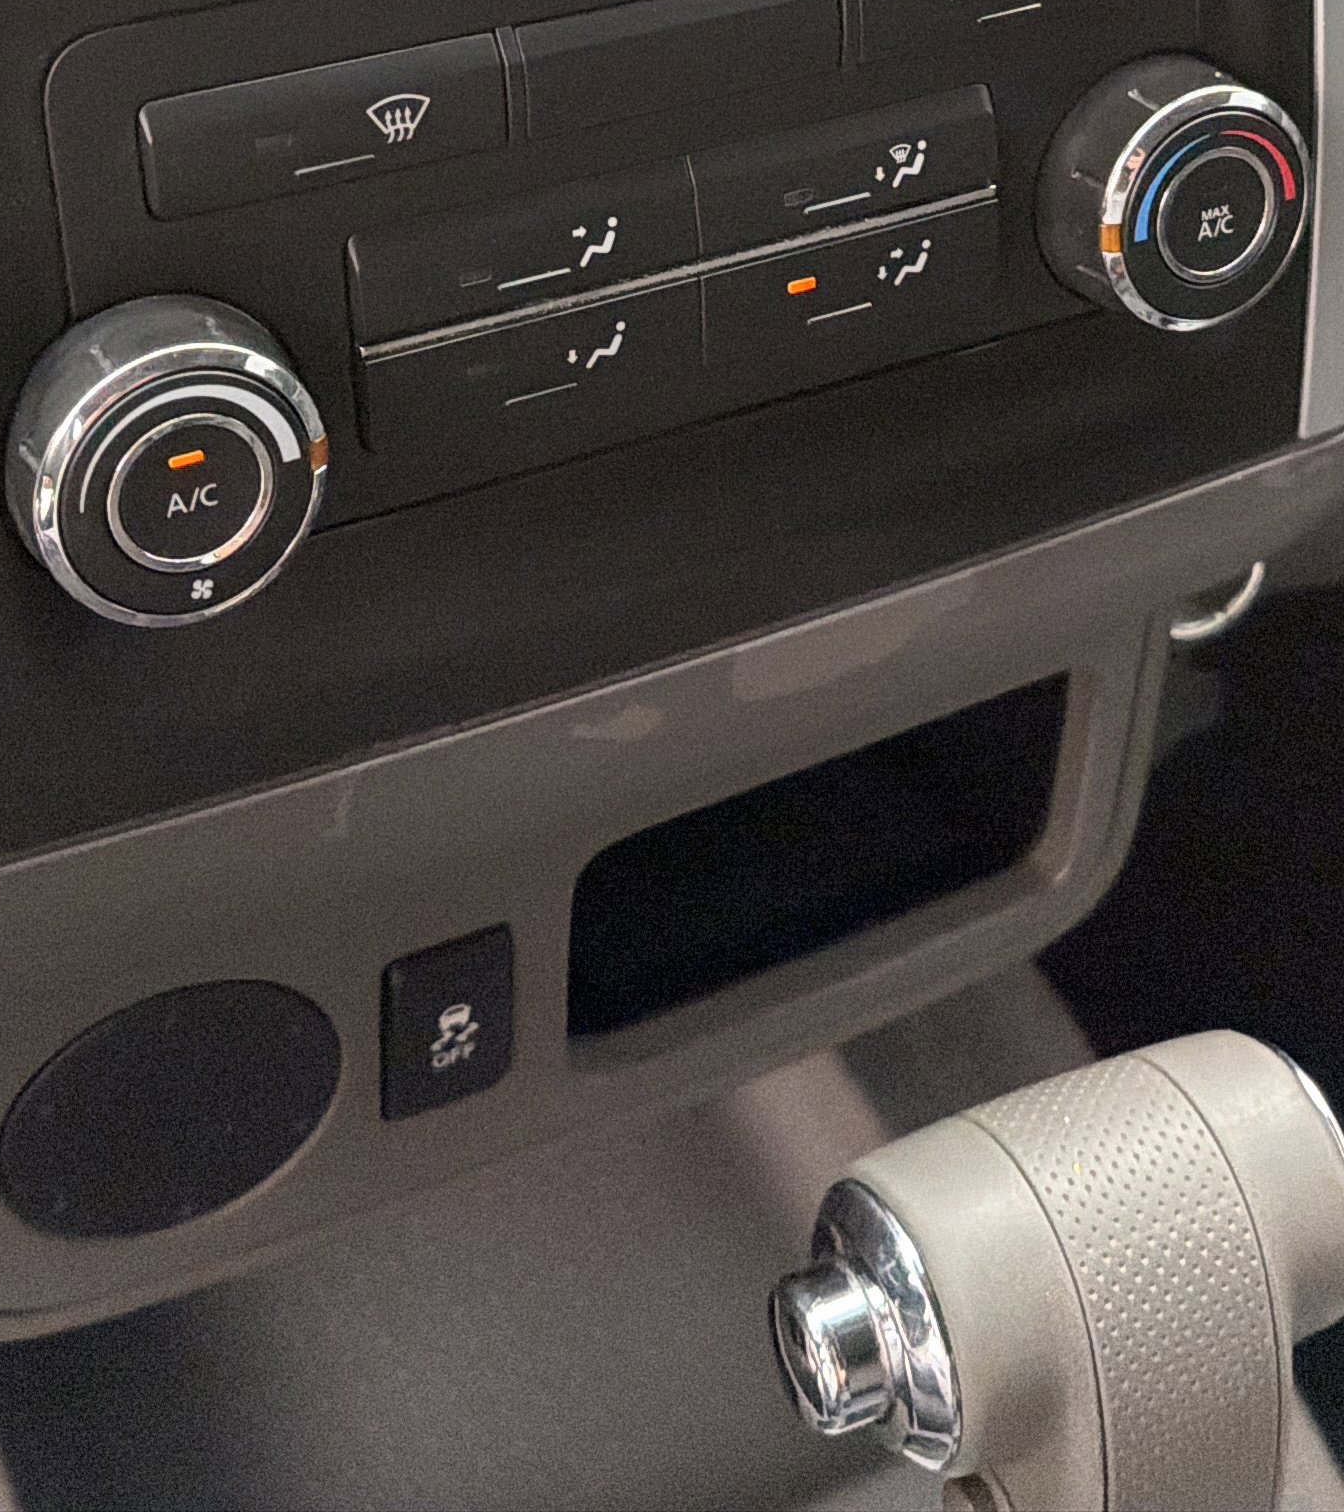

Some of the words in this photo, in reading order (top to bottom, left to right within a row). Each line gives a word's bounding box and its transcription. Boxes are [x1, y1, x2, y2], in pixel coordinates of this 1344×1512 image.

[1201, 204, 1230, 221] MAX
[1197, 216, 1234, 242] A/C
[166, 482, 219, 519] A/C
